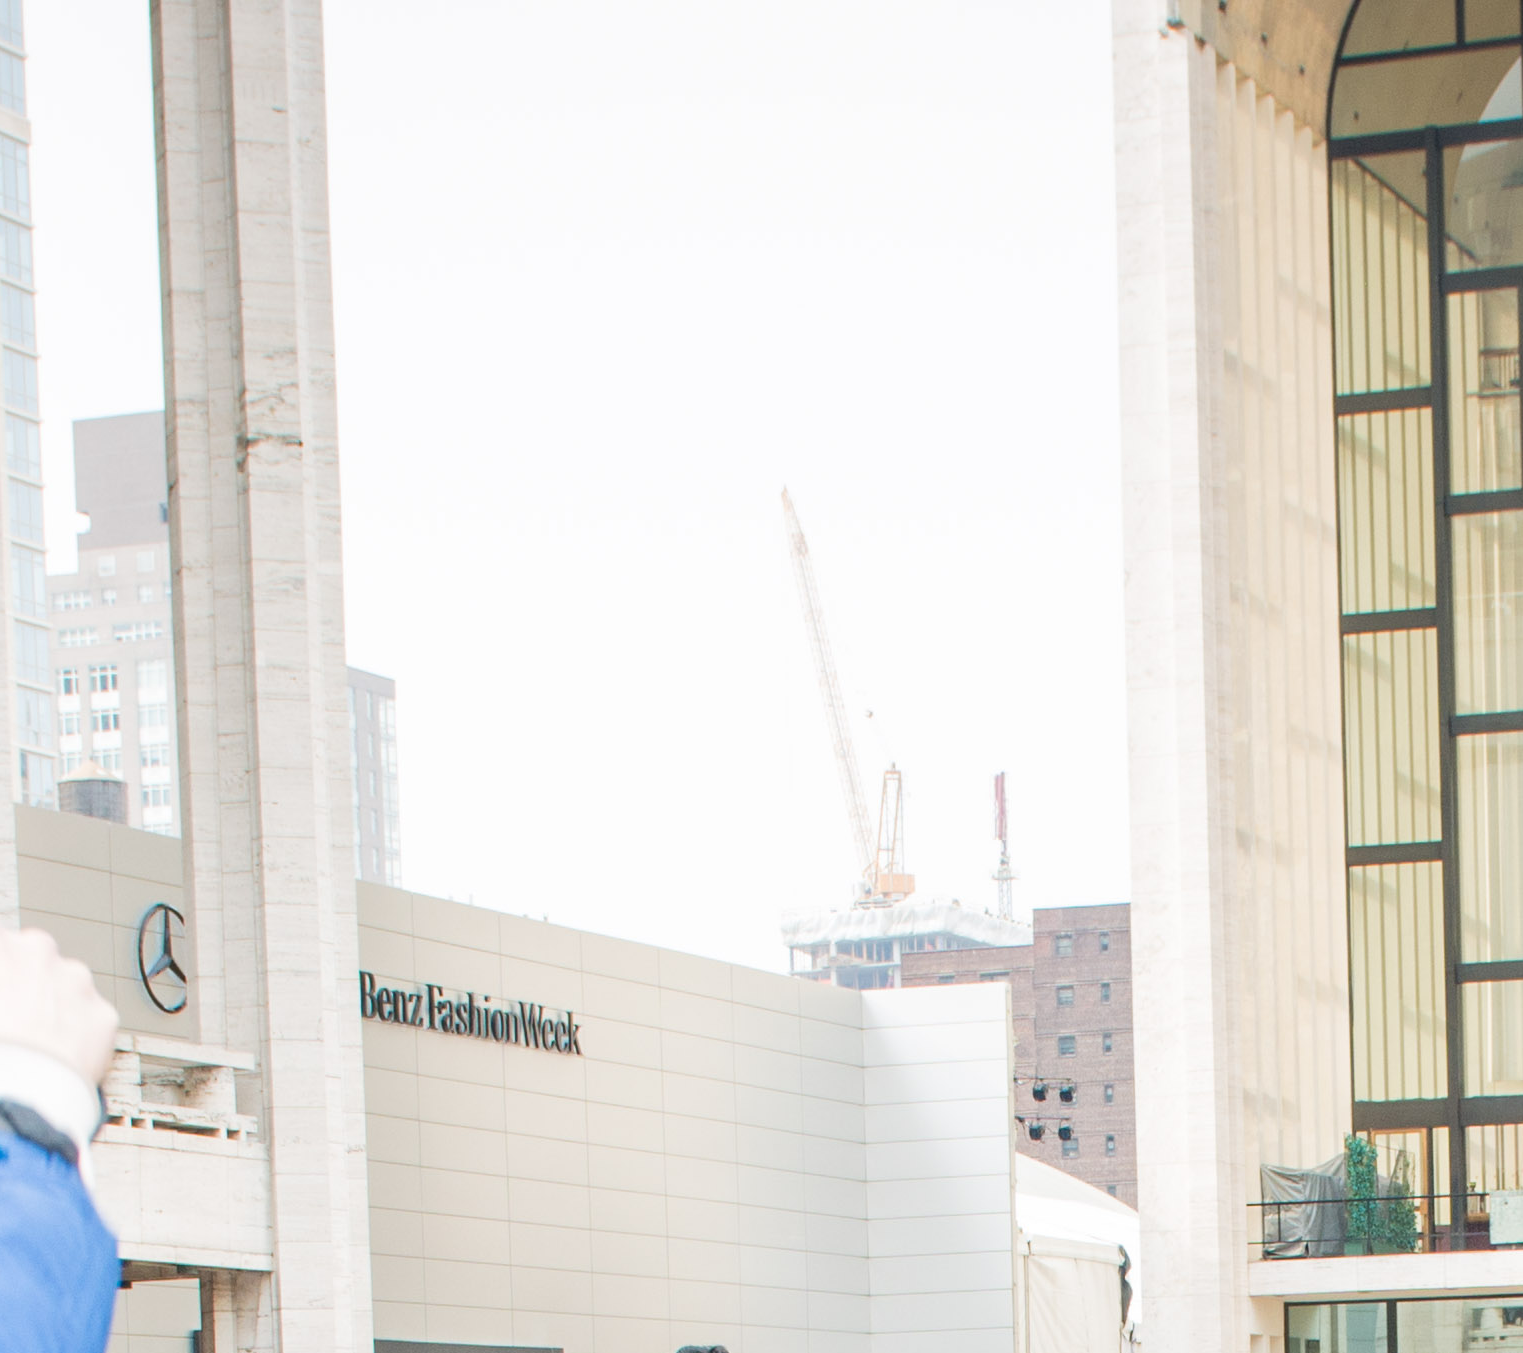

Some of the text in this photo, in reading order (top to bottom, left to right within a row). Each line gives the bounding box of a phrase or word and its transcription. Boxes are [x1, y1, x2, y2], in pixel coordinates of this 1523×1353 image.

[359, 970, 583, 1056] Benz Fashion Week
